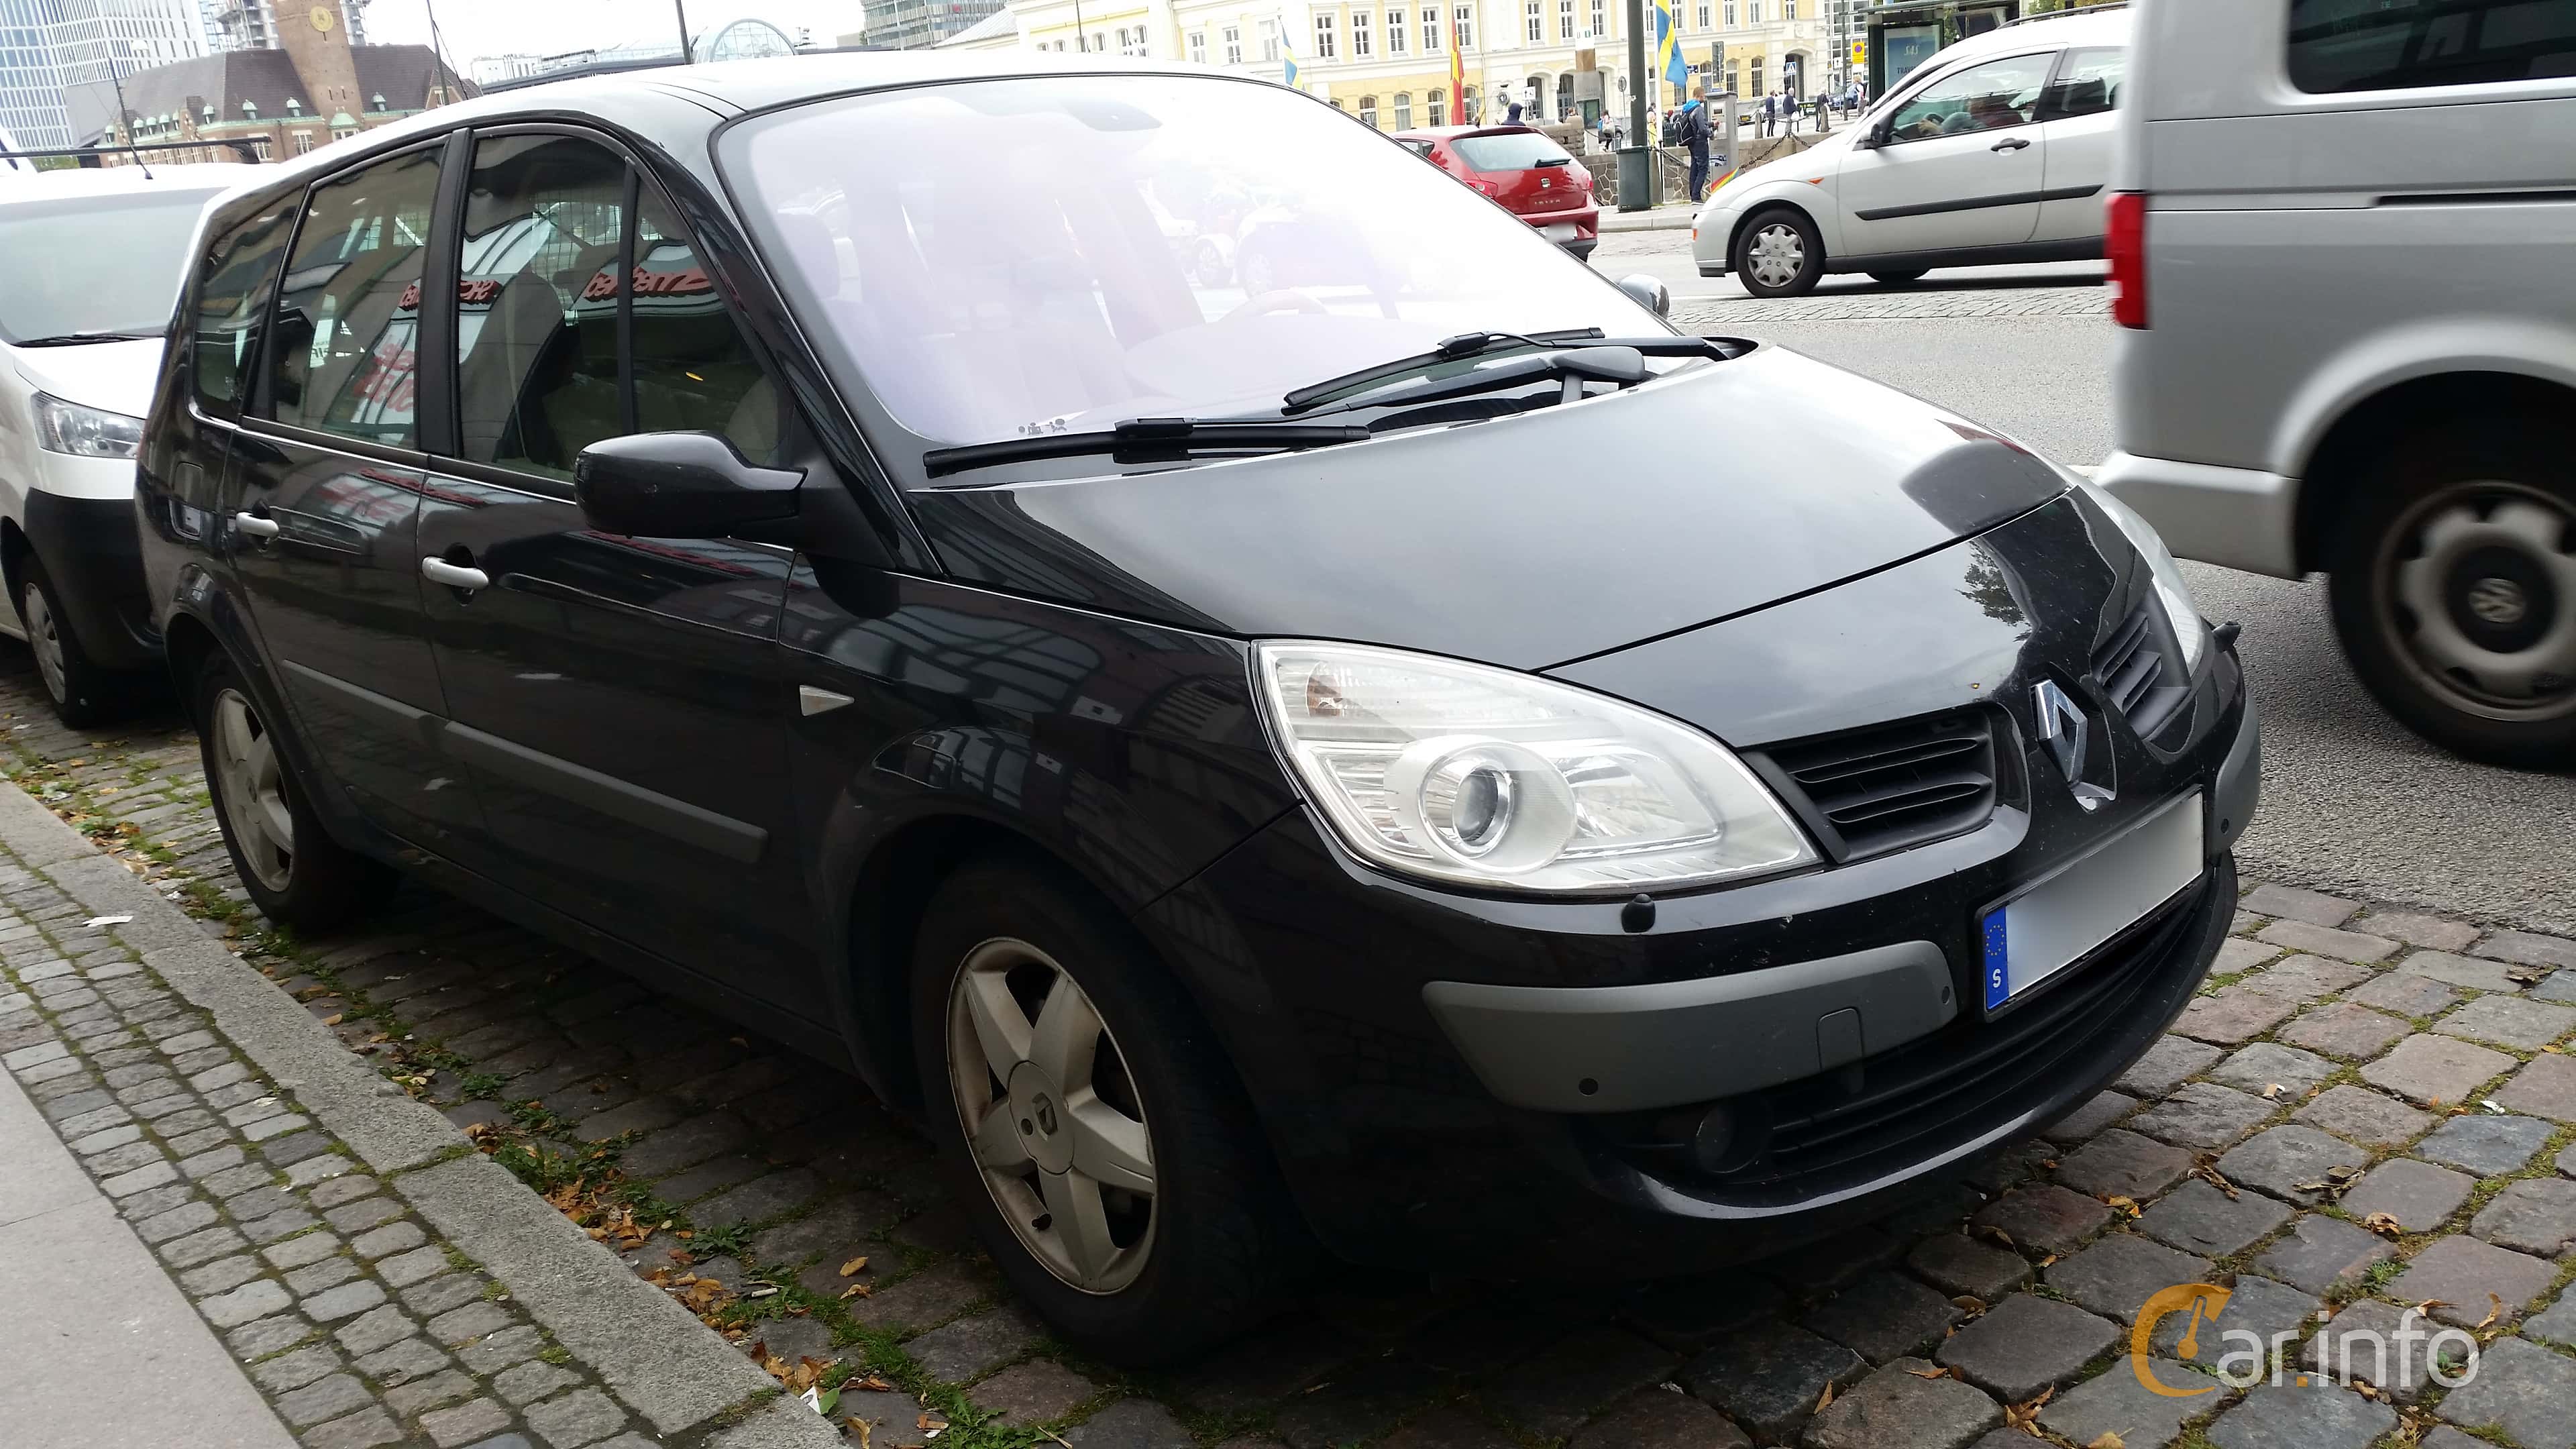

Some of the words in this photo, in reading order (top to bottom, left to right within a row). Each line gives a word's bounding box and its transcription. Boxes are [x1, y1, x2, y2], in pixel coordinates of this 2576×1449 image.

[1904, 45, 1920, 55] SAS
[1897, 66, 1916, 74] TRAVE
[1992, 969, 2001, 988] S
